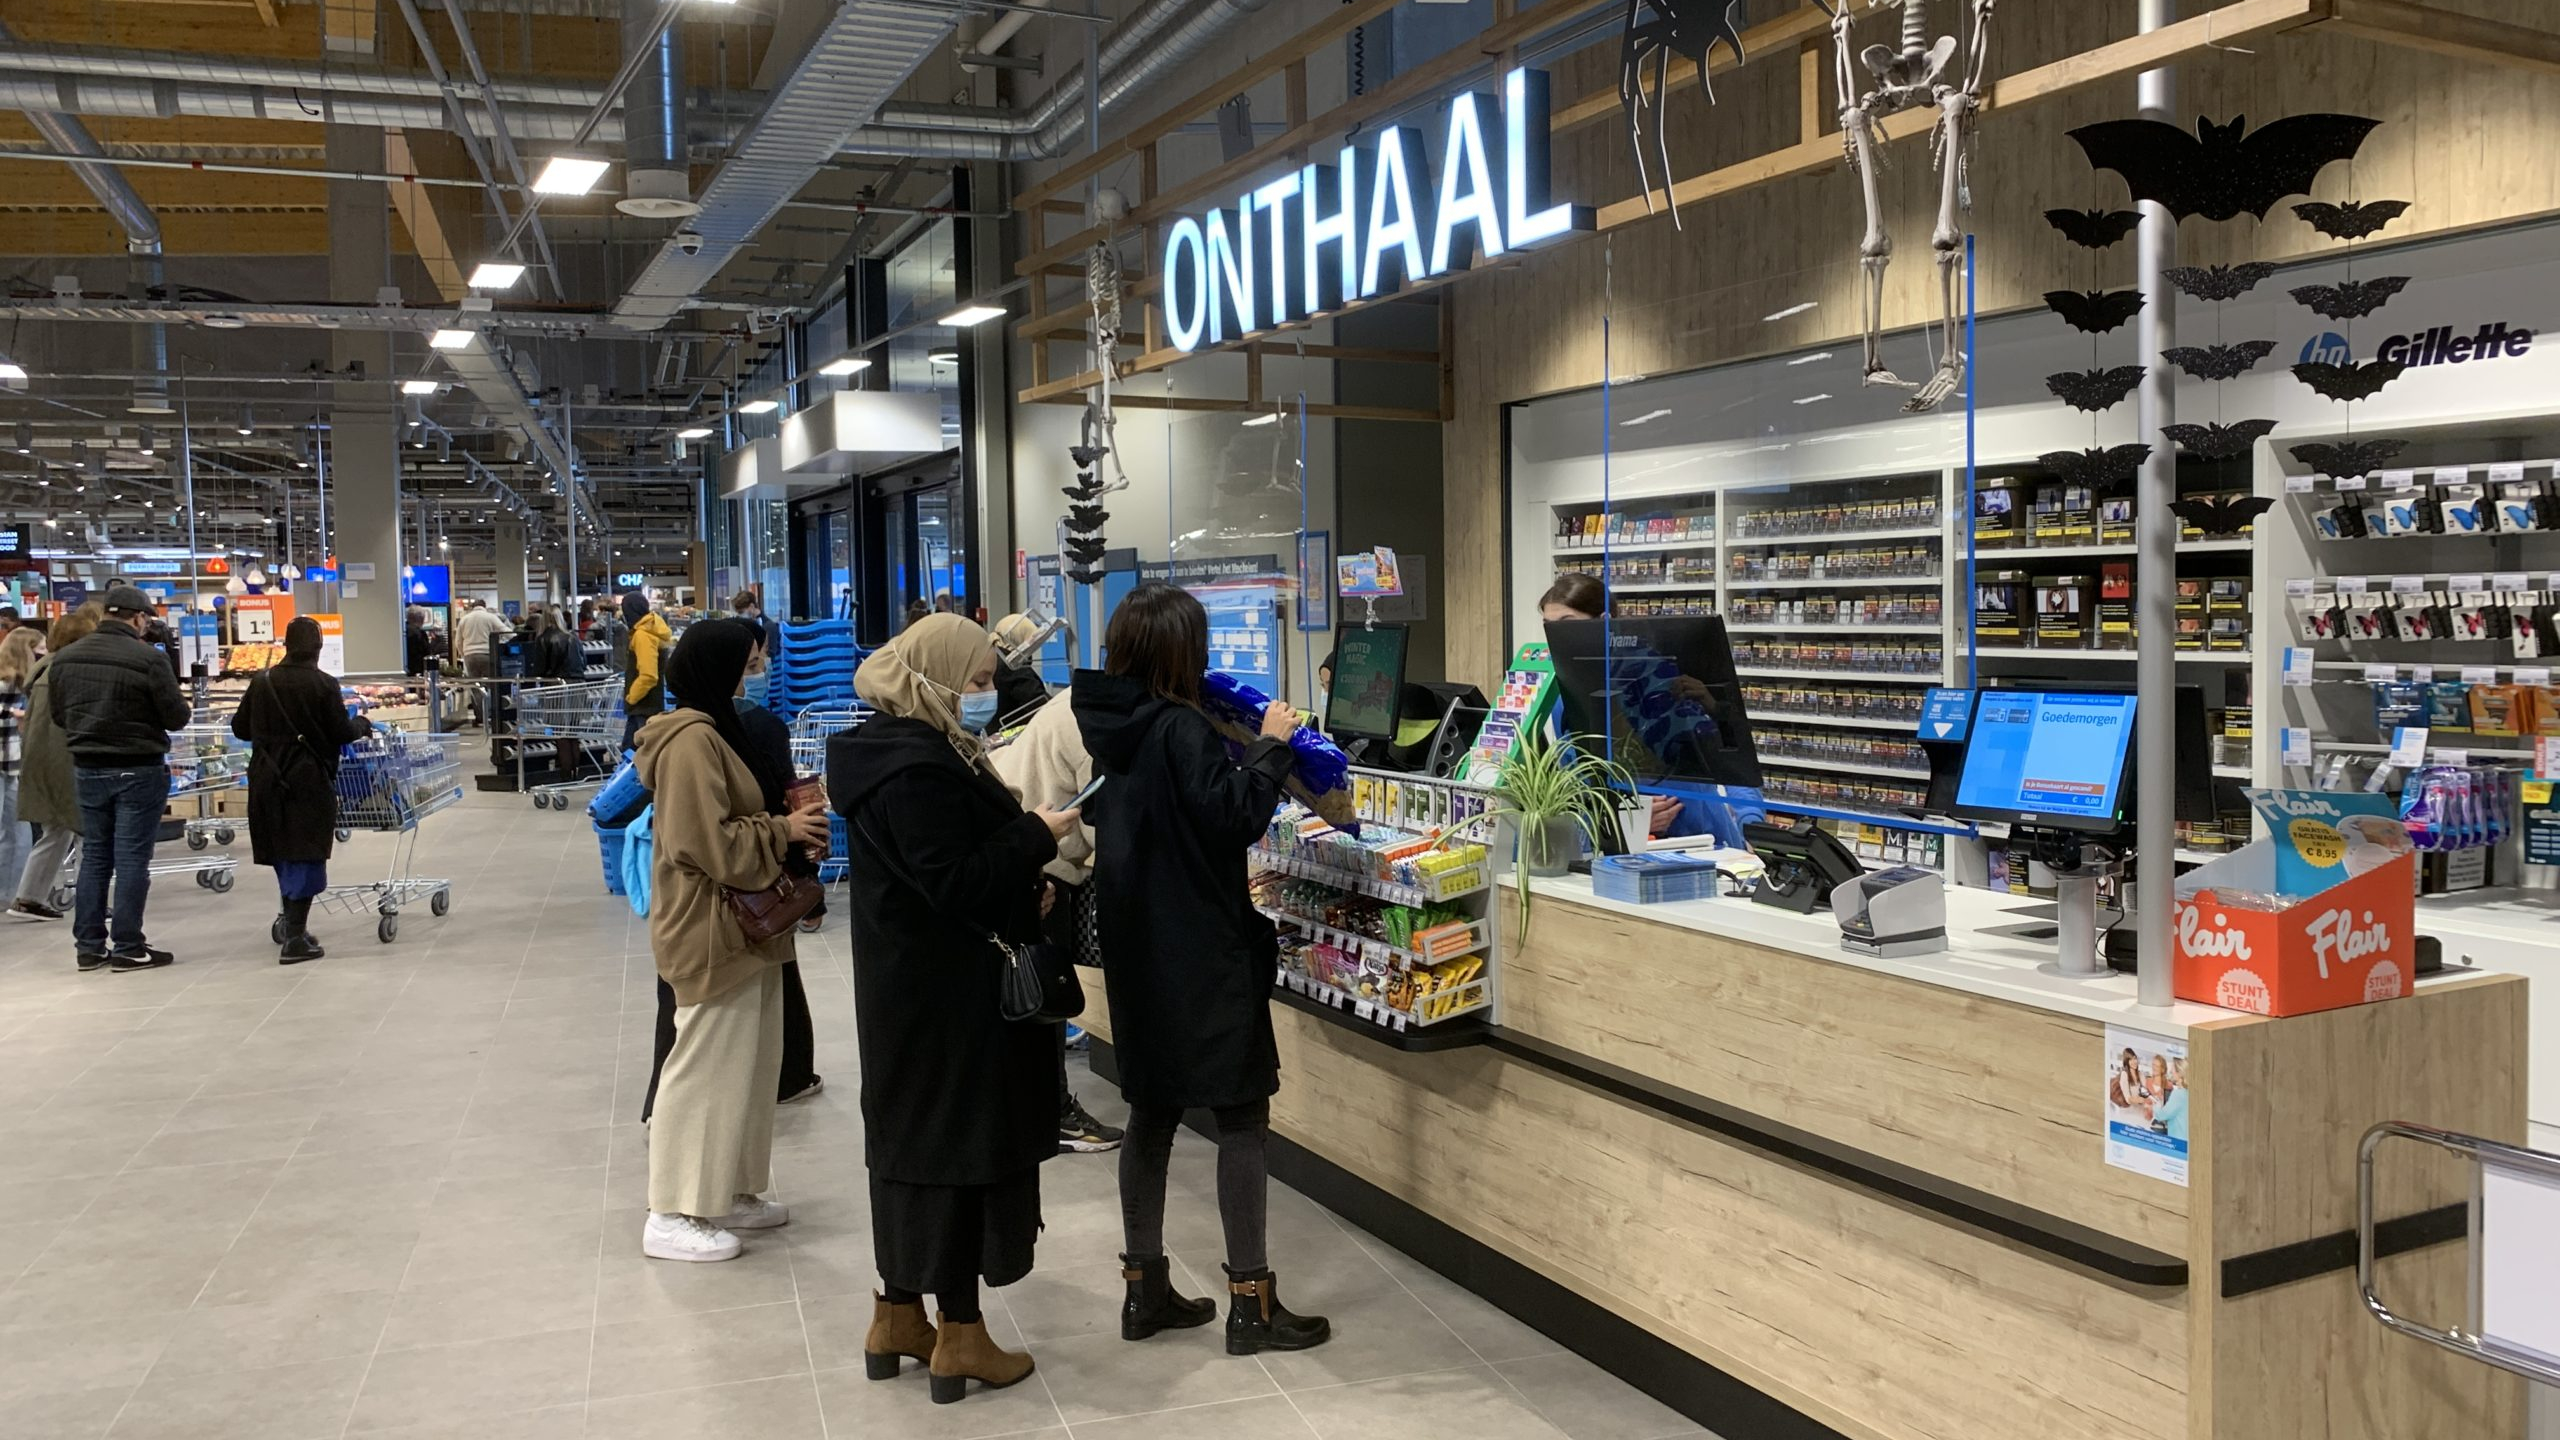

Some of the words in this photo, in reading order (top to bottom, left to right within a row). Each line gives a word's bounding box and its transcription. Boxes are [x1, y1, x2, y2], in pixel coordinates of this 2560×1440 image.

[1163, 66, 1573, 353] ONTHAAL
[2376, 322, 2533, 368] Gillette
[239, 599, 270, 607] BONUS
[1344, 642, 1371, 655] WINTER
[2041, 711, 2118, 727] Goedemorgen
[2023, 792, 2042, 800] Totaal
[2085, 797, 2100, 806] 0,00
[2243, 788, 2341, 820] Flair
[2292, 831, 2342, 842] FACEWASH
[2297, 825, 2330, 835] GRATIS
[2306, 847, 2314, 856] €
[2316, 848, 2338, 859] 8,95
[2175, 901, 2252, 961] lair
[2305, 908, 2391, 979] Flair
[2369, 973, 2399, 989] STUNT
[2222, 981, 2265, 999] STUNT
[2227, 995, 2260, 1012] DEAL
